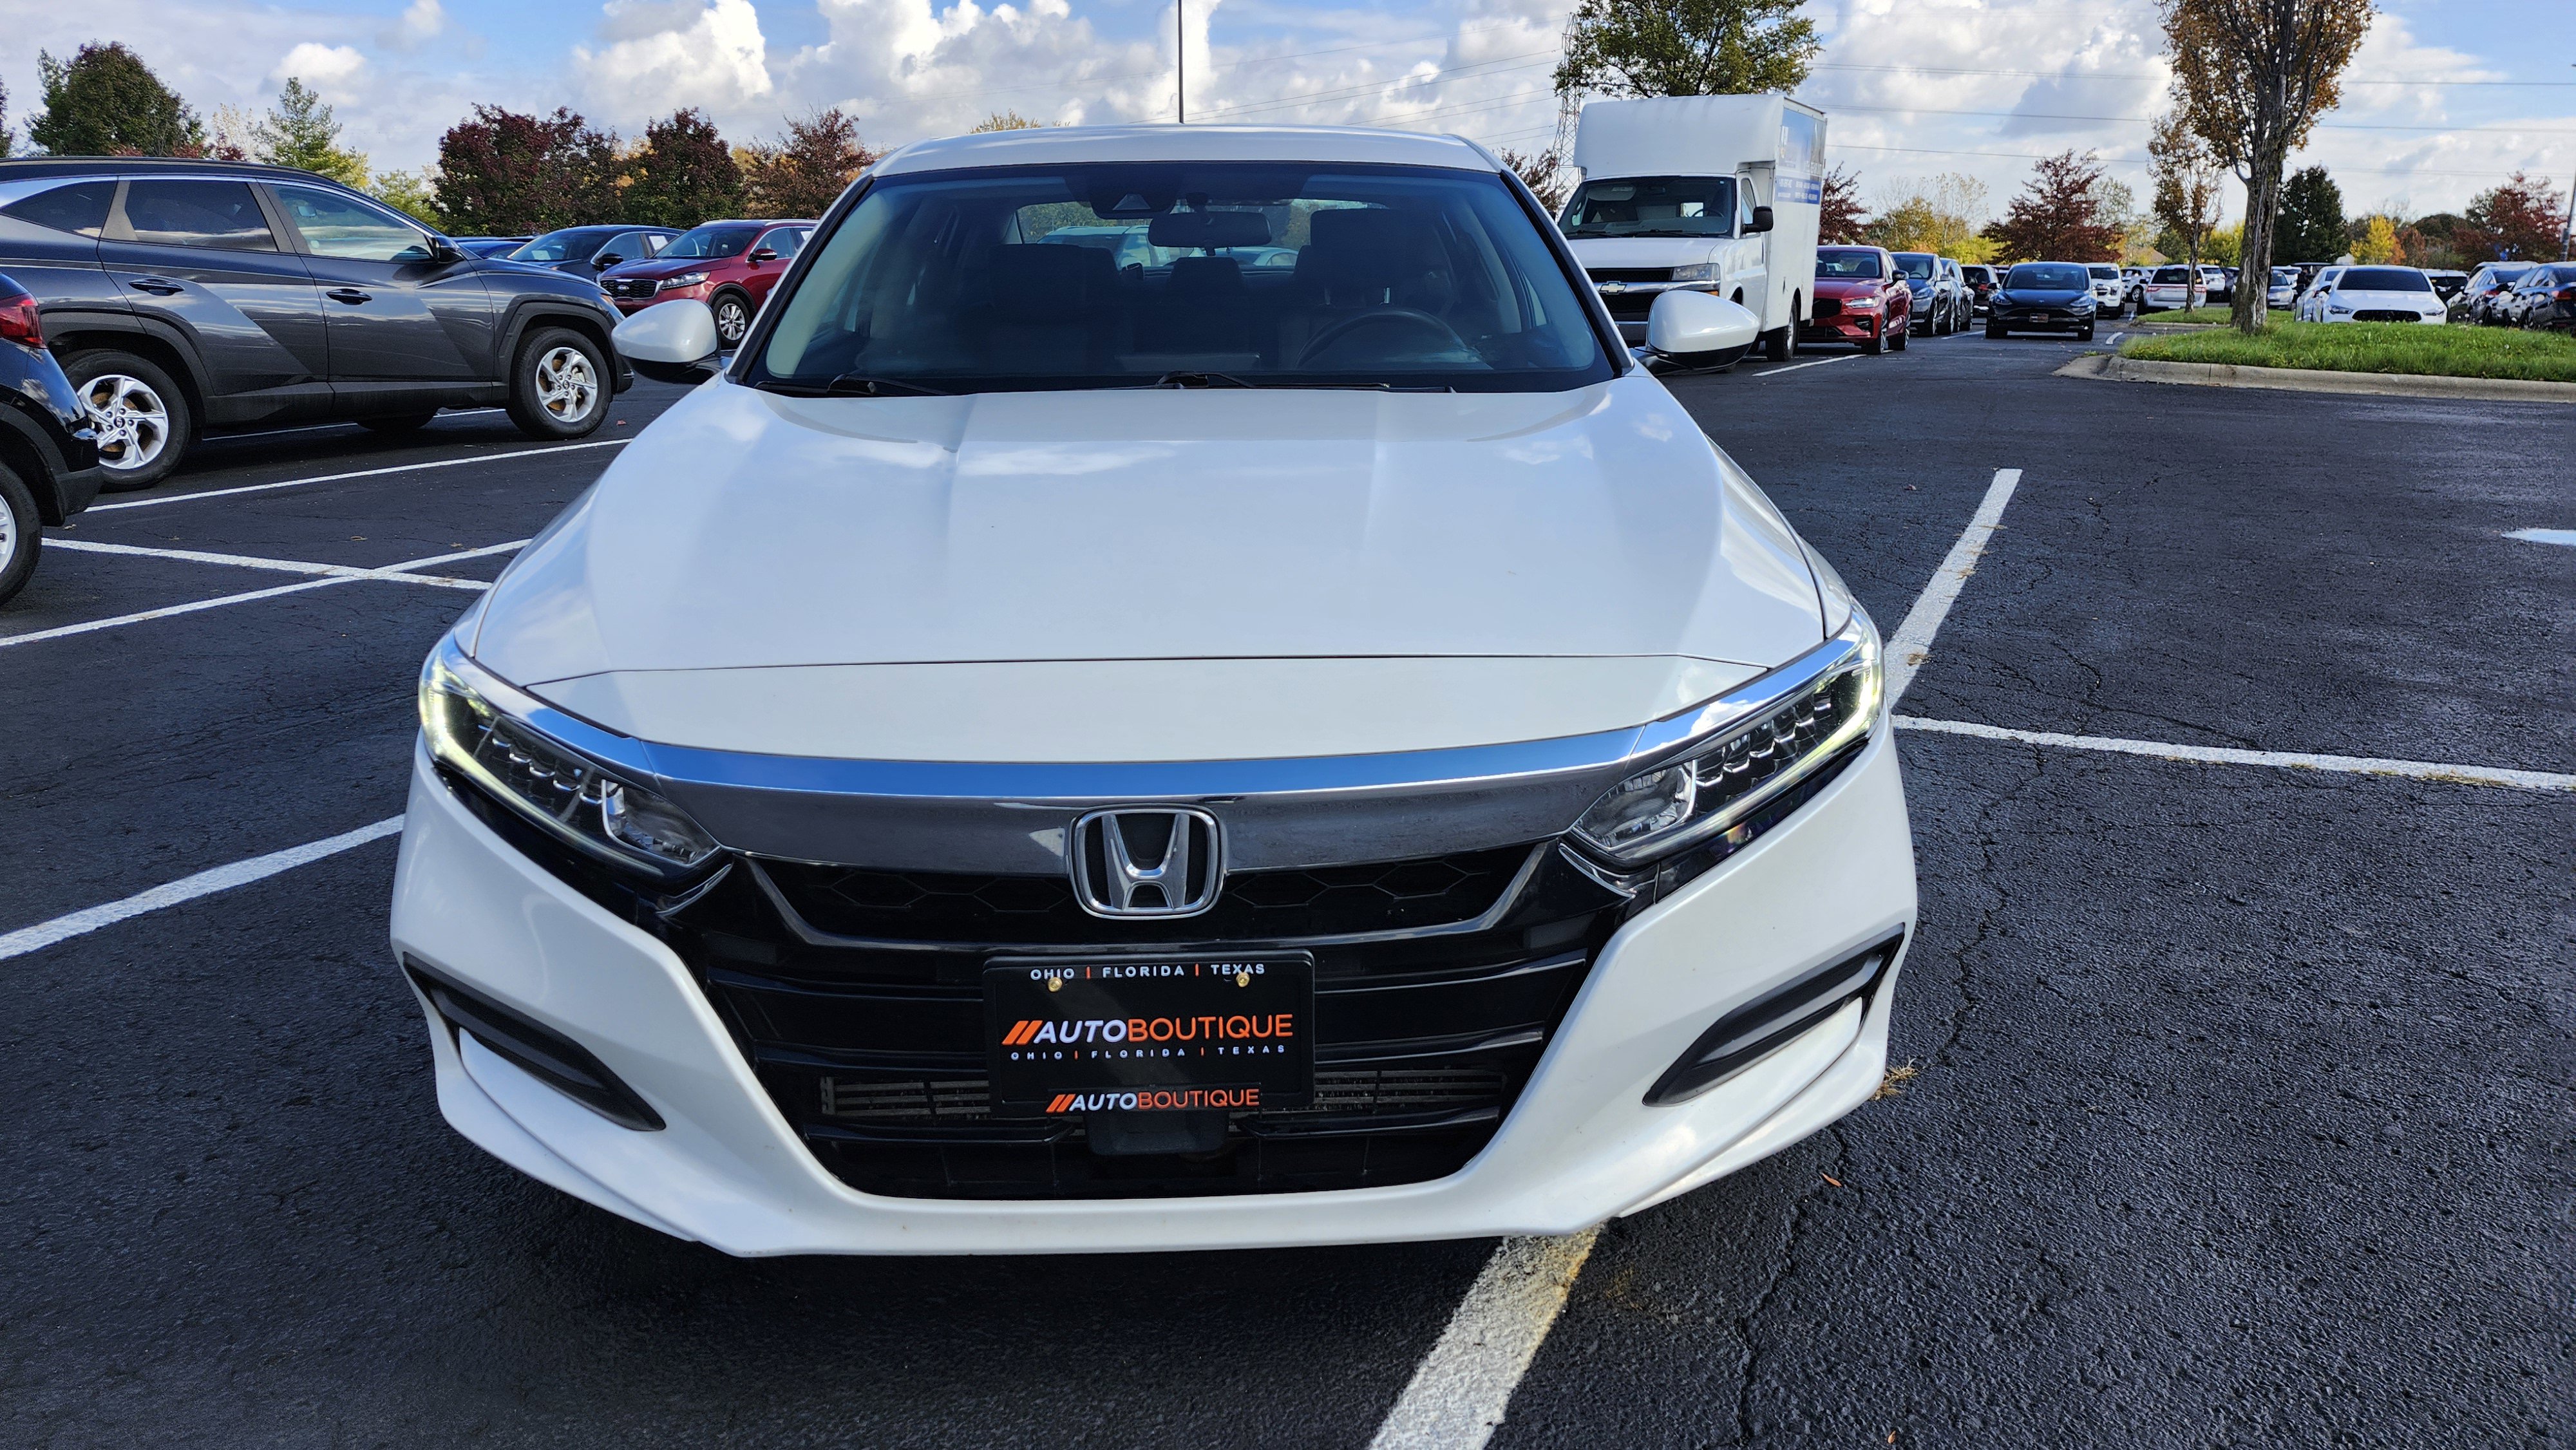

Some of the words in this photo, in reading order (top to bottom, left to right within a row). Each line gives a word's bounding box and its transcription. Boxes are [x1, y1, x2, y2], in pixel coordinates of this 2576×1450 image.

[1030, 968, 1075, 980] OHIO
[1103, 966, 1184, 978] FLORIDA
[1211, 964, 1265, 975] TEXAS
[1033, 1013, 1293, 1044] AUTOBOUTIQUE
[1010, 1051, 1063, 1061] OHIO
[1091, 1048, 1185, 1059] FLORIDA
[1218, 1044, 1285, 1055] TEXAS
[1069, 1089, 1260, 1112] AUTOBOUTIQUE
